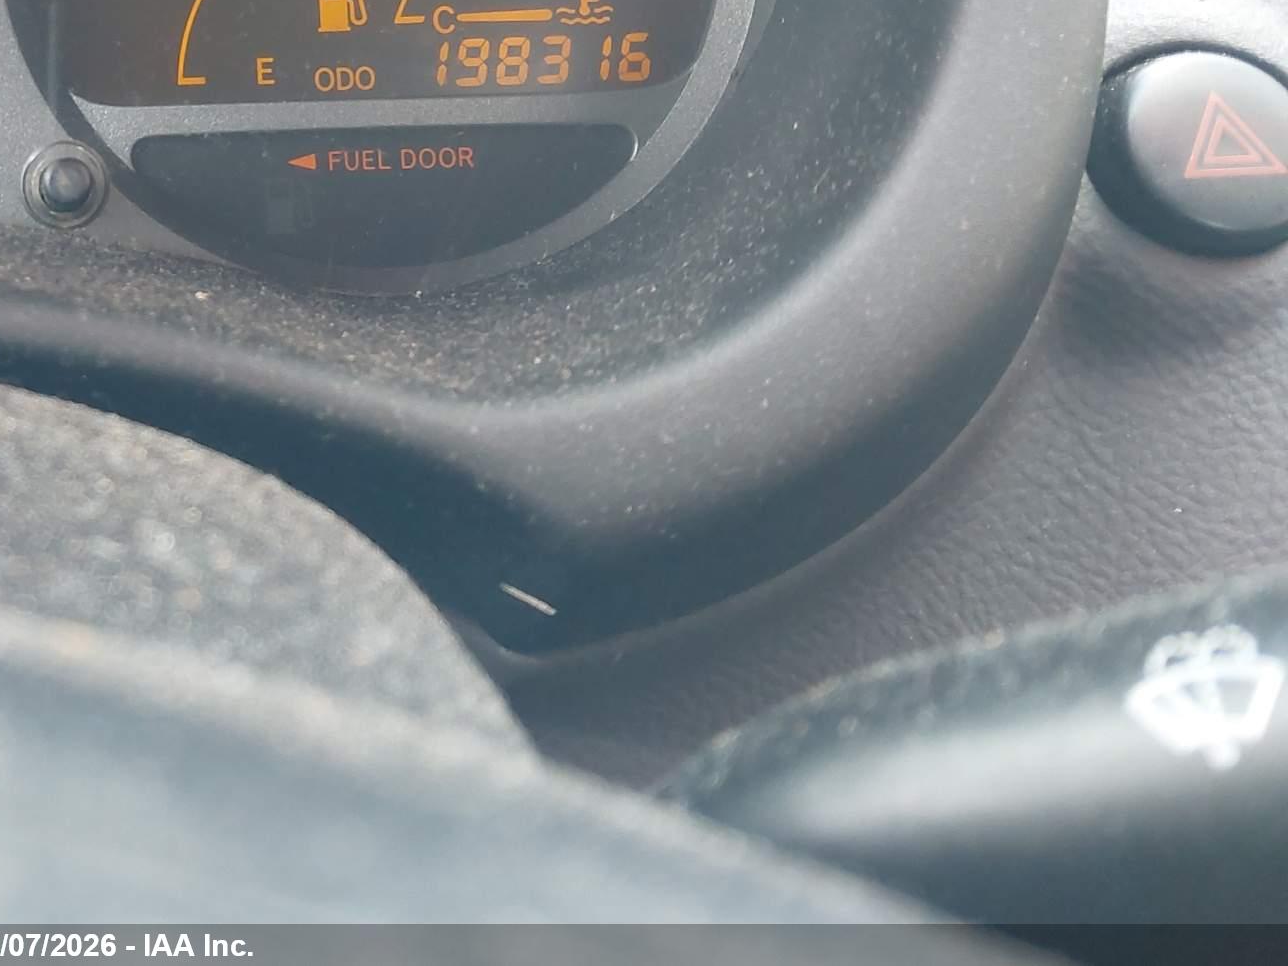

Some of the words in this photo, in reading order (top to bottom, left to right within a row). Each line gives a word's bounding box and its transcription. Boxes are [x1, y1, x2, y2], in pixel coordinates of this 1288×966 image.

[432, 7, 455, 34] C
[255, 56, 275, 85] E
[314, 66, 376, 91] ODO
[436, 32, 652, 87] 198316
[327, 149, 391, 171] FUEL
[399, 146, 474, 171] DOOR
